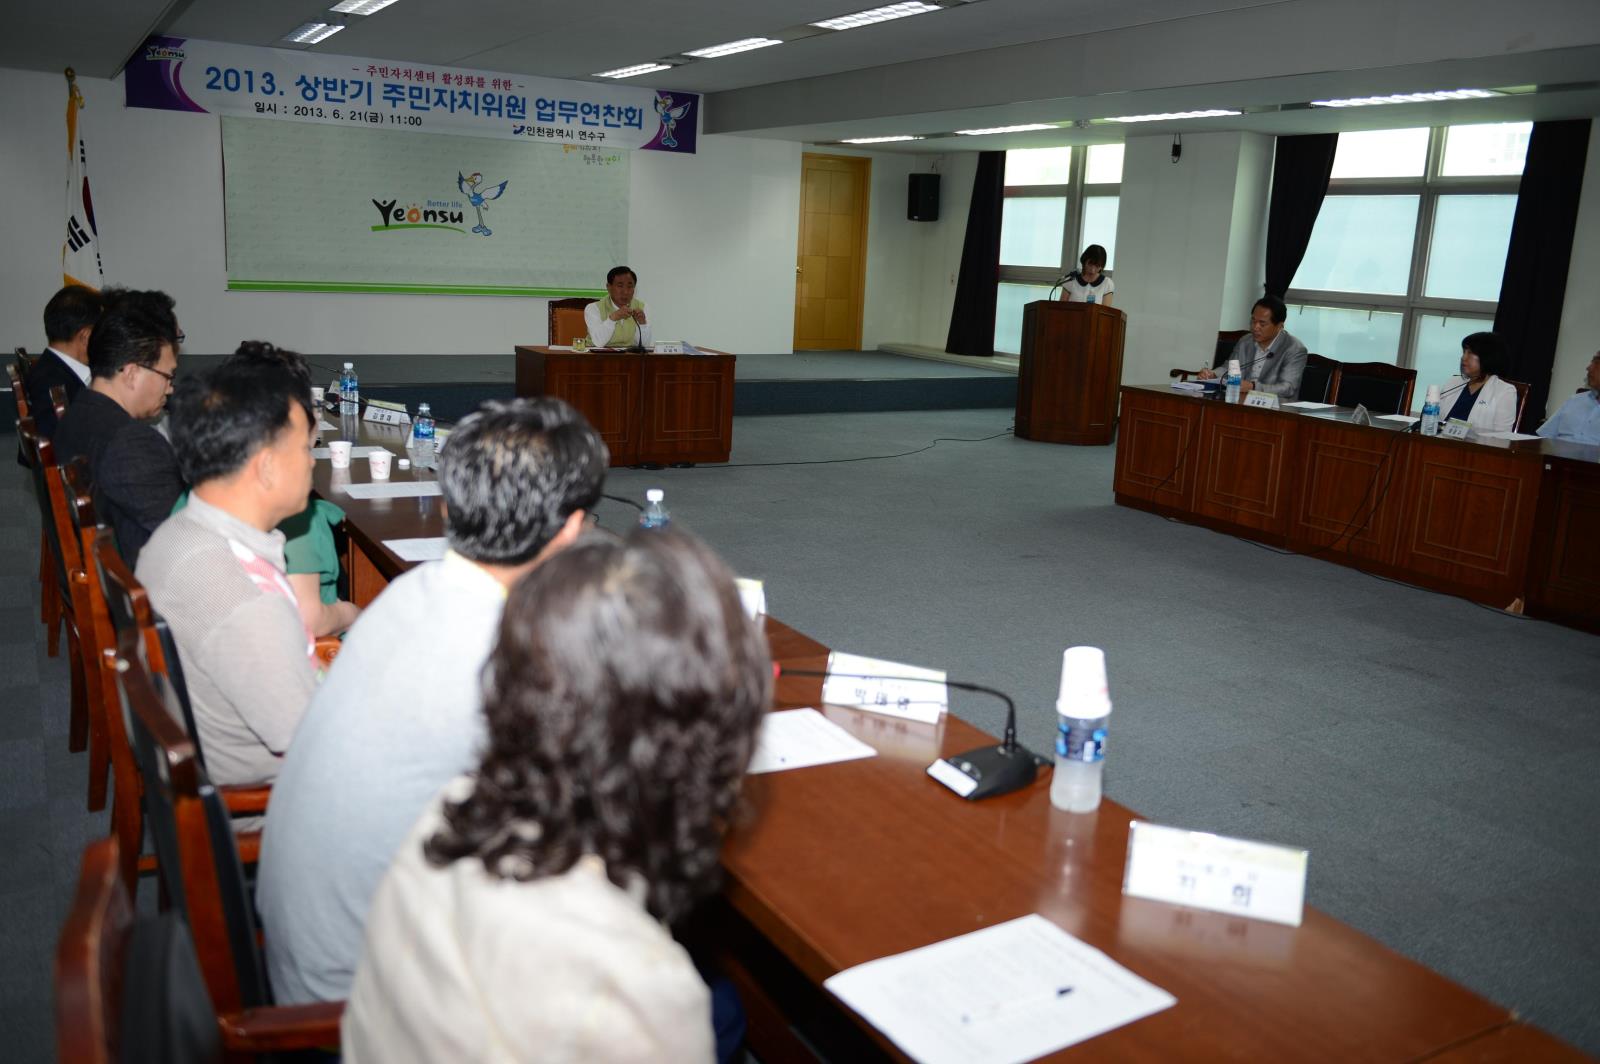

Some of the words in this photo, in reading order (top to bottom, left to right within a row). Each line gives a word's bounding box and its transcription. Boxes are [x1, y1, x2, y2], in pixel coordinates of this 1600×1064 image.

[366, 65, 435, 83] 주민자치센터
[442, 73, 486, 89] 활성화를
[491, 79, 512, 91] 위한
[205, 66, 284, 96] 2013.
[295, 75, 372, 106] 상반기
[382, 83, 526, 120] 주민자치위원
[535, 98, 643, 130] 업무연찬회
[254, 101, 277, 114] 일시
[294, 105, 327, 119] 2013.
[332, 109, 344, 120] 6.
[350, 110, 384, 123] 21(금)
[390, 114, 422, 126] 11:00
[526, 126, 574, 139] 인천광역시
[578, 130, 606, 142] 연수구
[371, 199, 463, 227] Yeonsu
